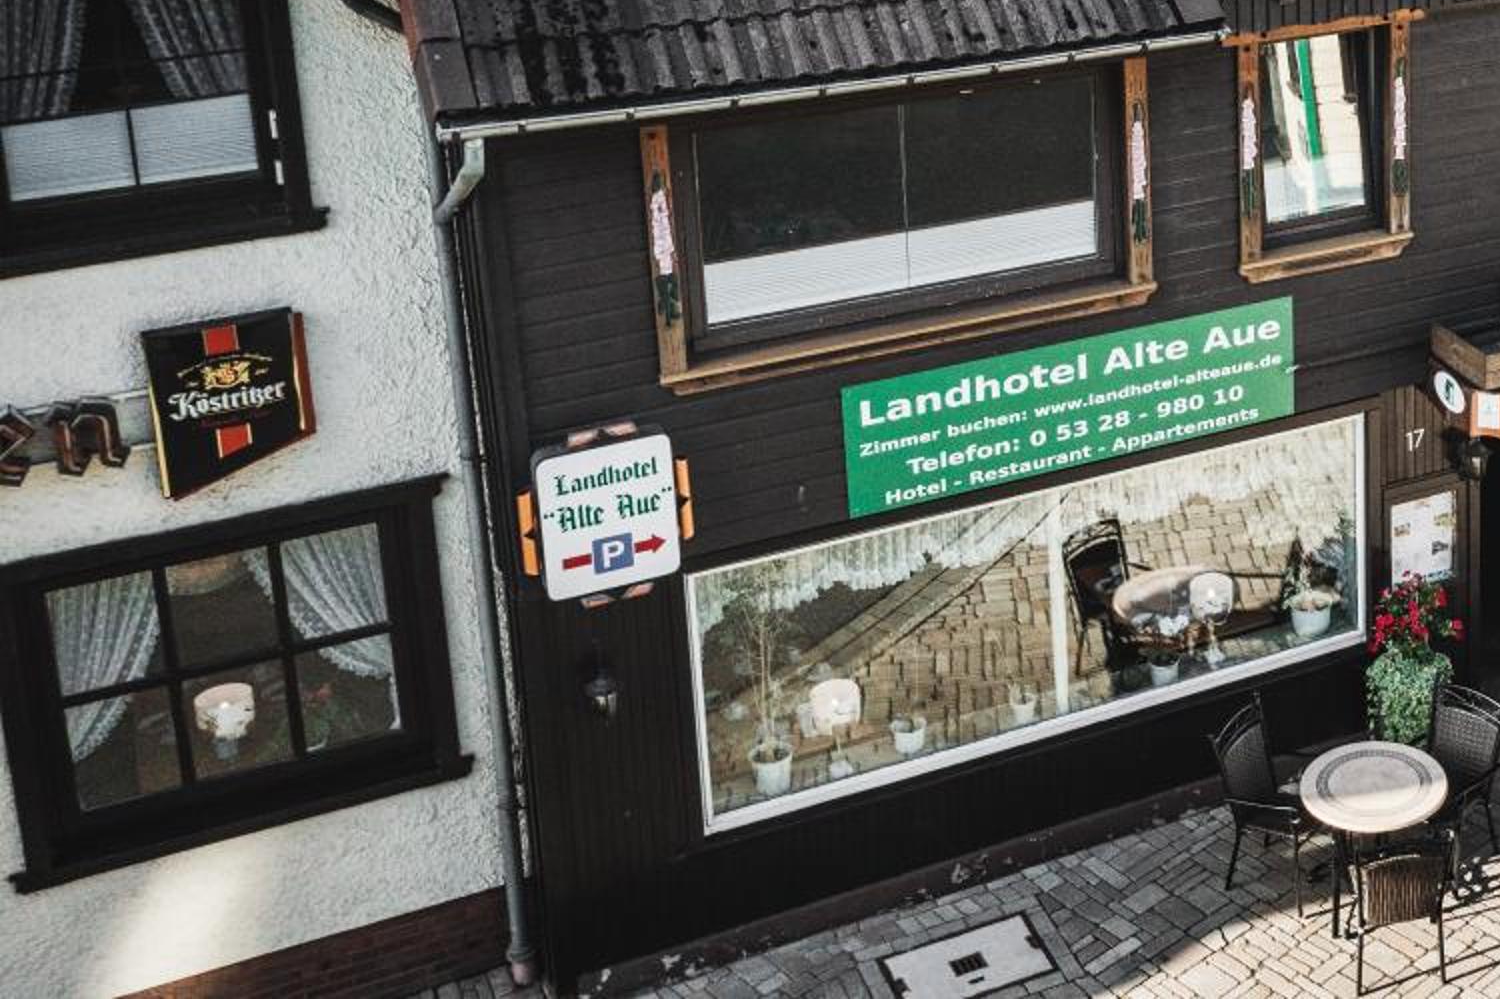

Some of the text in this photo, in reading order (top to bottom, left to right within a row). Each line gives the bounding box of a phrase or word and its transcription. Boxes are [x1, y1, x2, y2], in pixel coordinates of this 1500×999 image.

[168, 381, 287, 421] Köstritzer
[859, 354, 1282, 457] Zimmer buchen: www.landhotel-alteaue.de
[860, 320, 1281, 427] Landhotel Alte Aue
[885, 478, 947, 505] Hotel
[969, 446, 1092, 485] Restaurant
[1112, 407, 1260, 452] Appartements
[906, 439, 1020, 475] Telefon:
[1029, 429, 1047, 447] 0
[1056, 419, 1088, 441] 53
[1098, 410, 1130, 432] 28
[1157, 394, 1204, 419] 980
[1213, 385, 1244, 406] 10
[1405, 428, 1425, 452] 17
[554, 457, 658, 496] Landhotel
[602, 540, 625, 569] P
